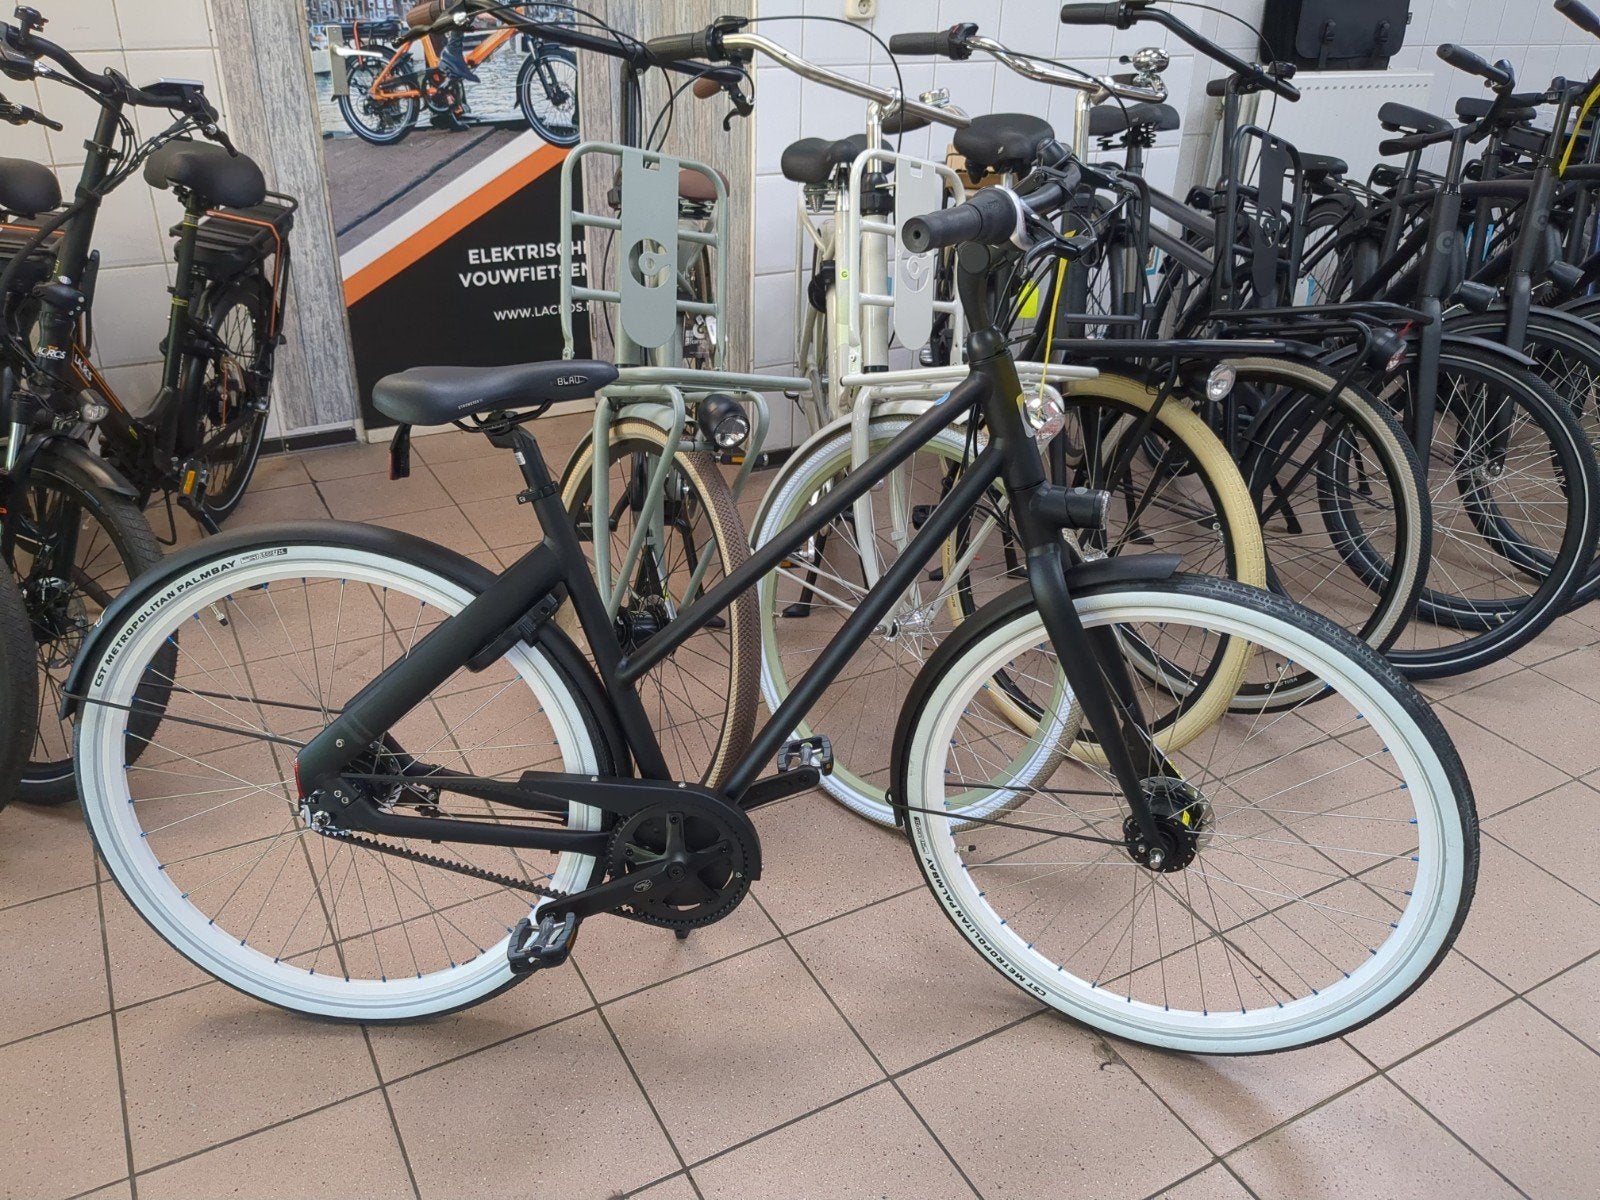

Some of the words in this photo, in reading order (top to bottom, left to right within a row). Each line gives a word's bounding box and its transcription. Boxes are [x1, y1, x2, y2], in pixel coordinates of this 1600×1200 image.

[468, 240, 587, 265] ELEKTRISH
[458, 262, 588, 288] VOUWFIETEN
[94, 666, 107, 688] CST
[106, 590, 176, 667] METROPOLITAN
[177, 559, 236, 592] PALMBAY
[925, 857, 956, 909] PALMBAY
[955, 909, 1027, 982] METROPOLITAN
[1025, 981, 1047, 997] CST
